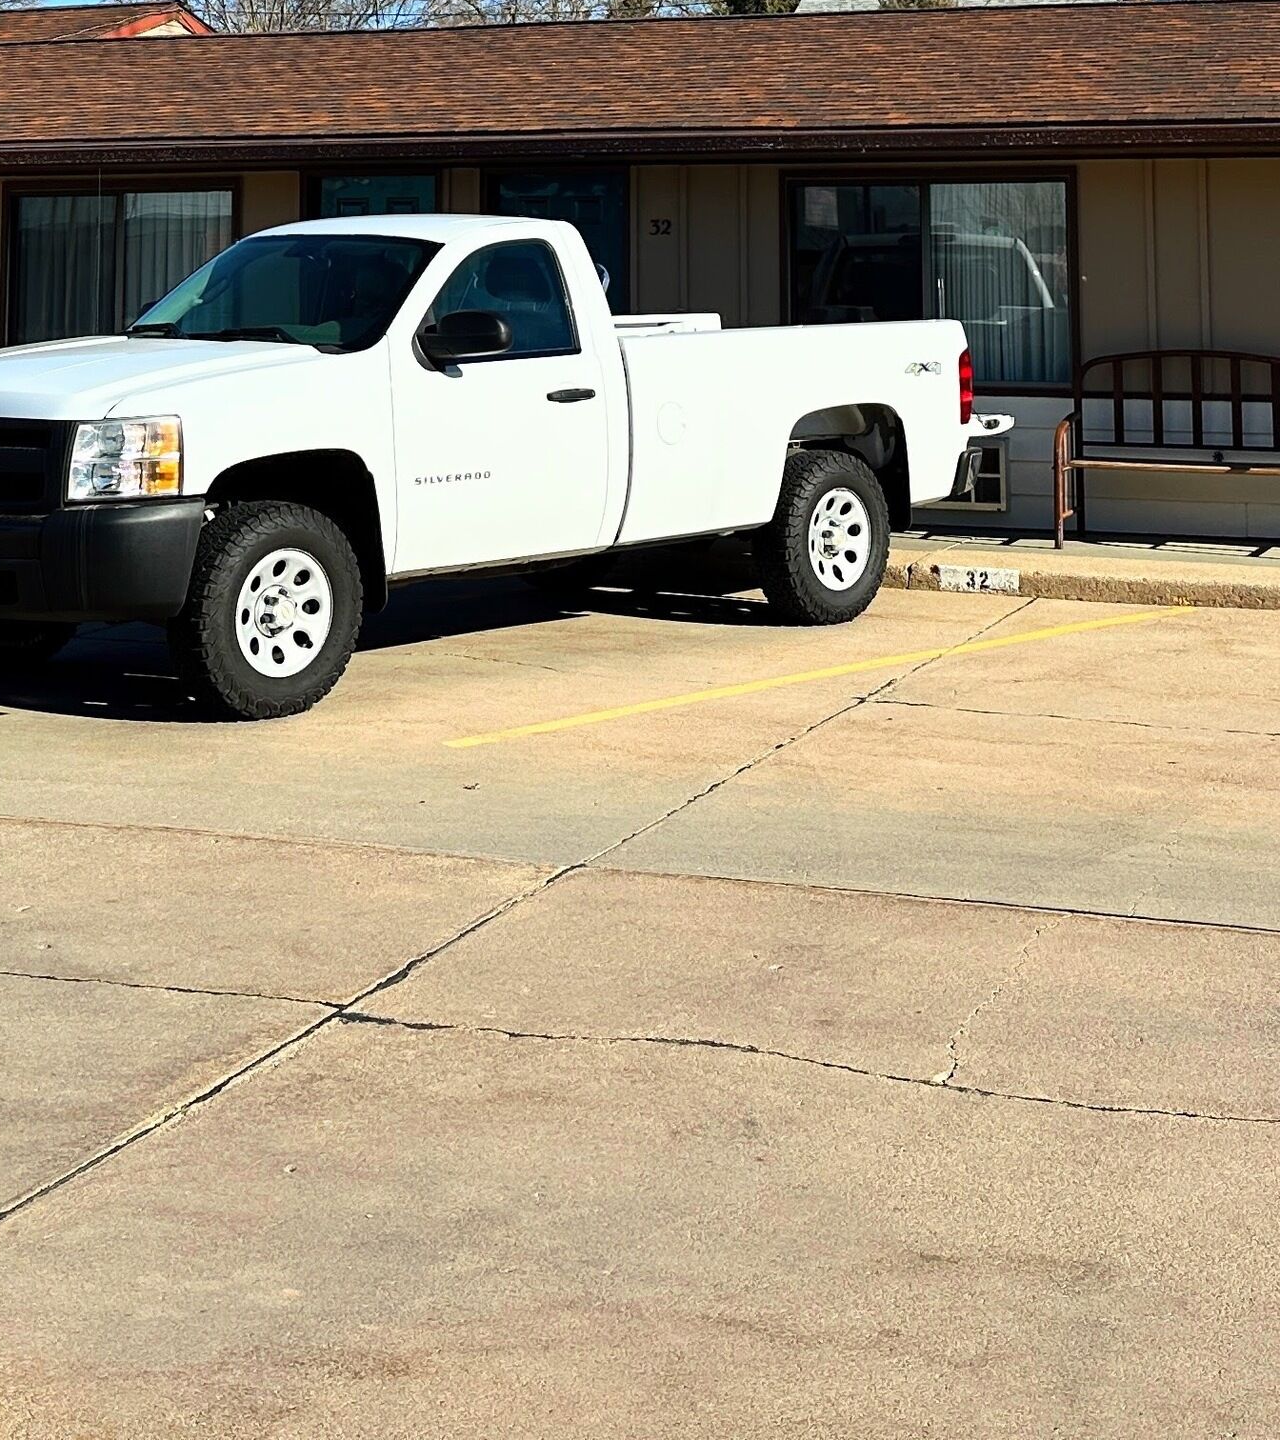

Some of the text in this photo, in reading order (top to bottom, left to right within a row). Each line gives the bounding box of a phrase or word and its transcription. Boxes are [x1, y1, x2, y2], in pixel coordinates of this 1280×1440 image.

[649, 219, 671, 235] 32
[414, 470, 491, 486] SILVERADO
[966, 570, 990, 590] 32
